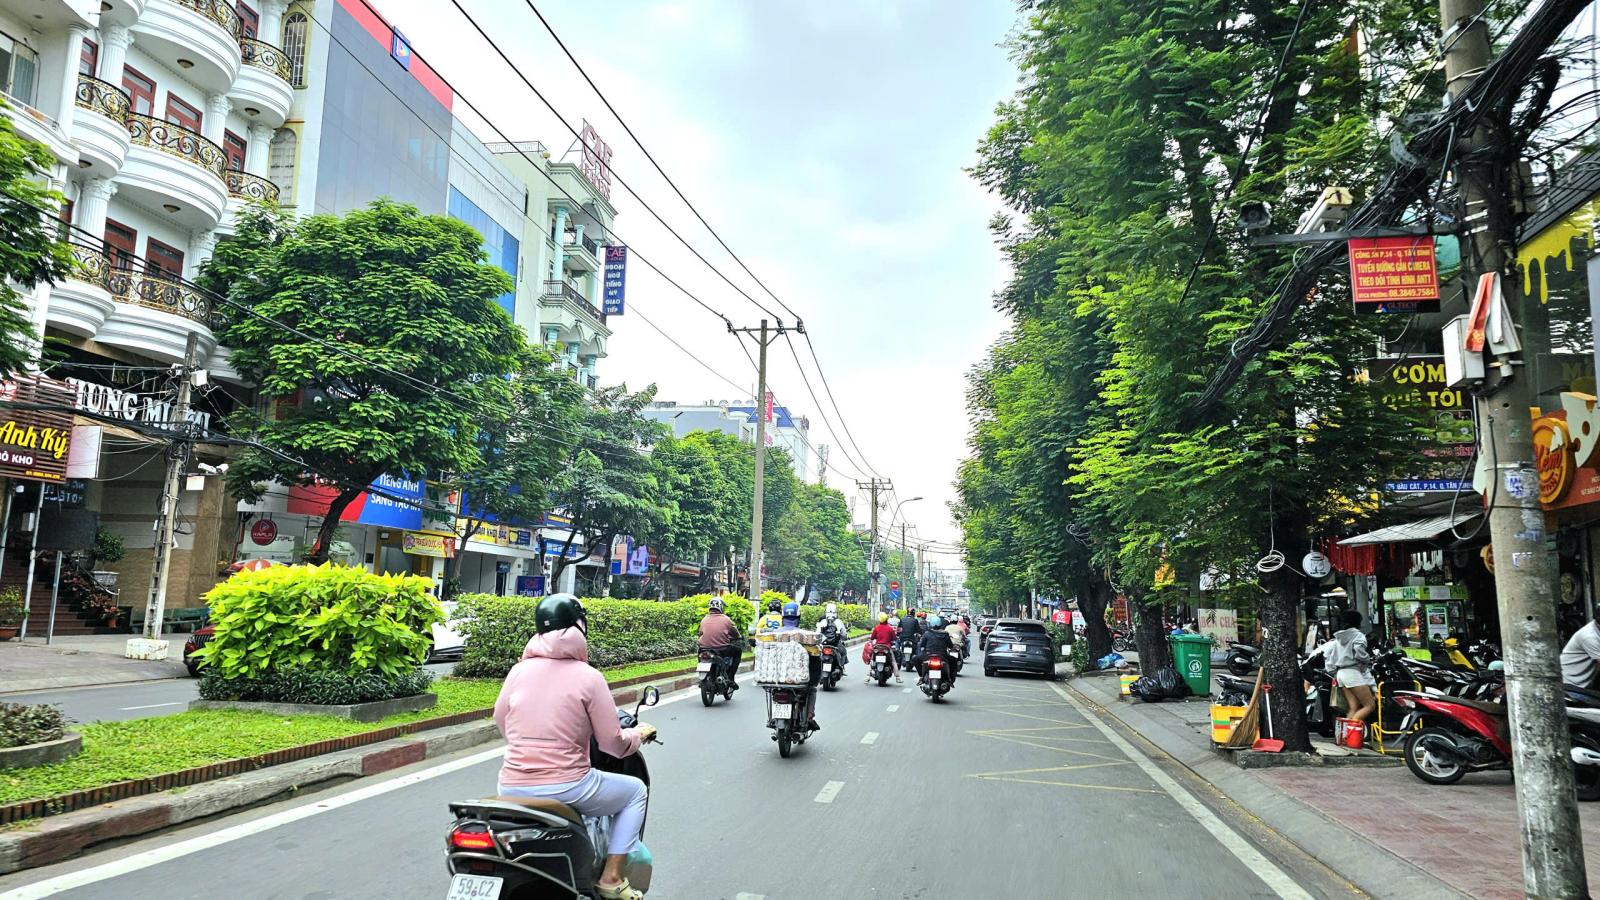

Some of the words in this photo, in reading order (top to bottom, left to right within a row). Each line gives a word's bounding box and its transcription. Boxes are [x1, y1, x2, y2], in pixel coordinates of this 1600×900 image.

[606, 247, 625, 257] CAE
[1392, 361, 1446, 384] CƠM
[1427, 388, 1462, 407] TÔI
[0, 421, 37, 448] Anh
[41, 428, 68, 459] Ký
[12, 454, 33, 465] KHO
[403, 480, 419, 492] ANH
[766, 617, 780, 630] be
